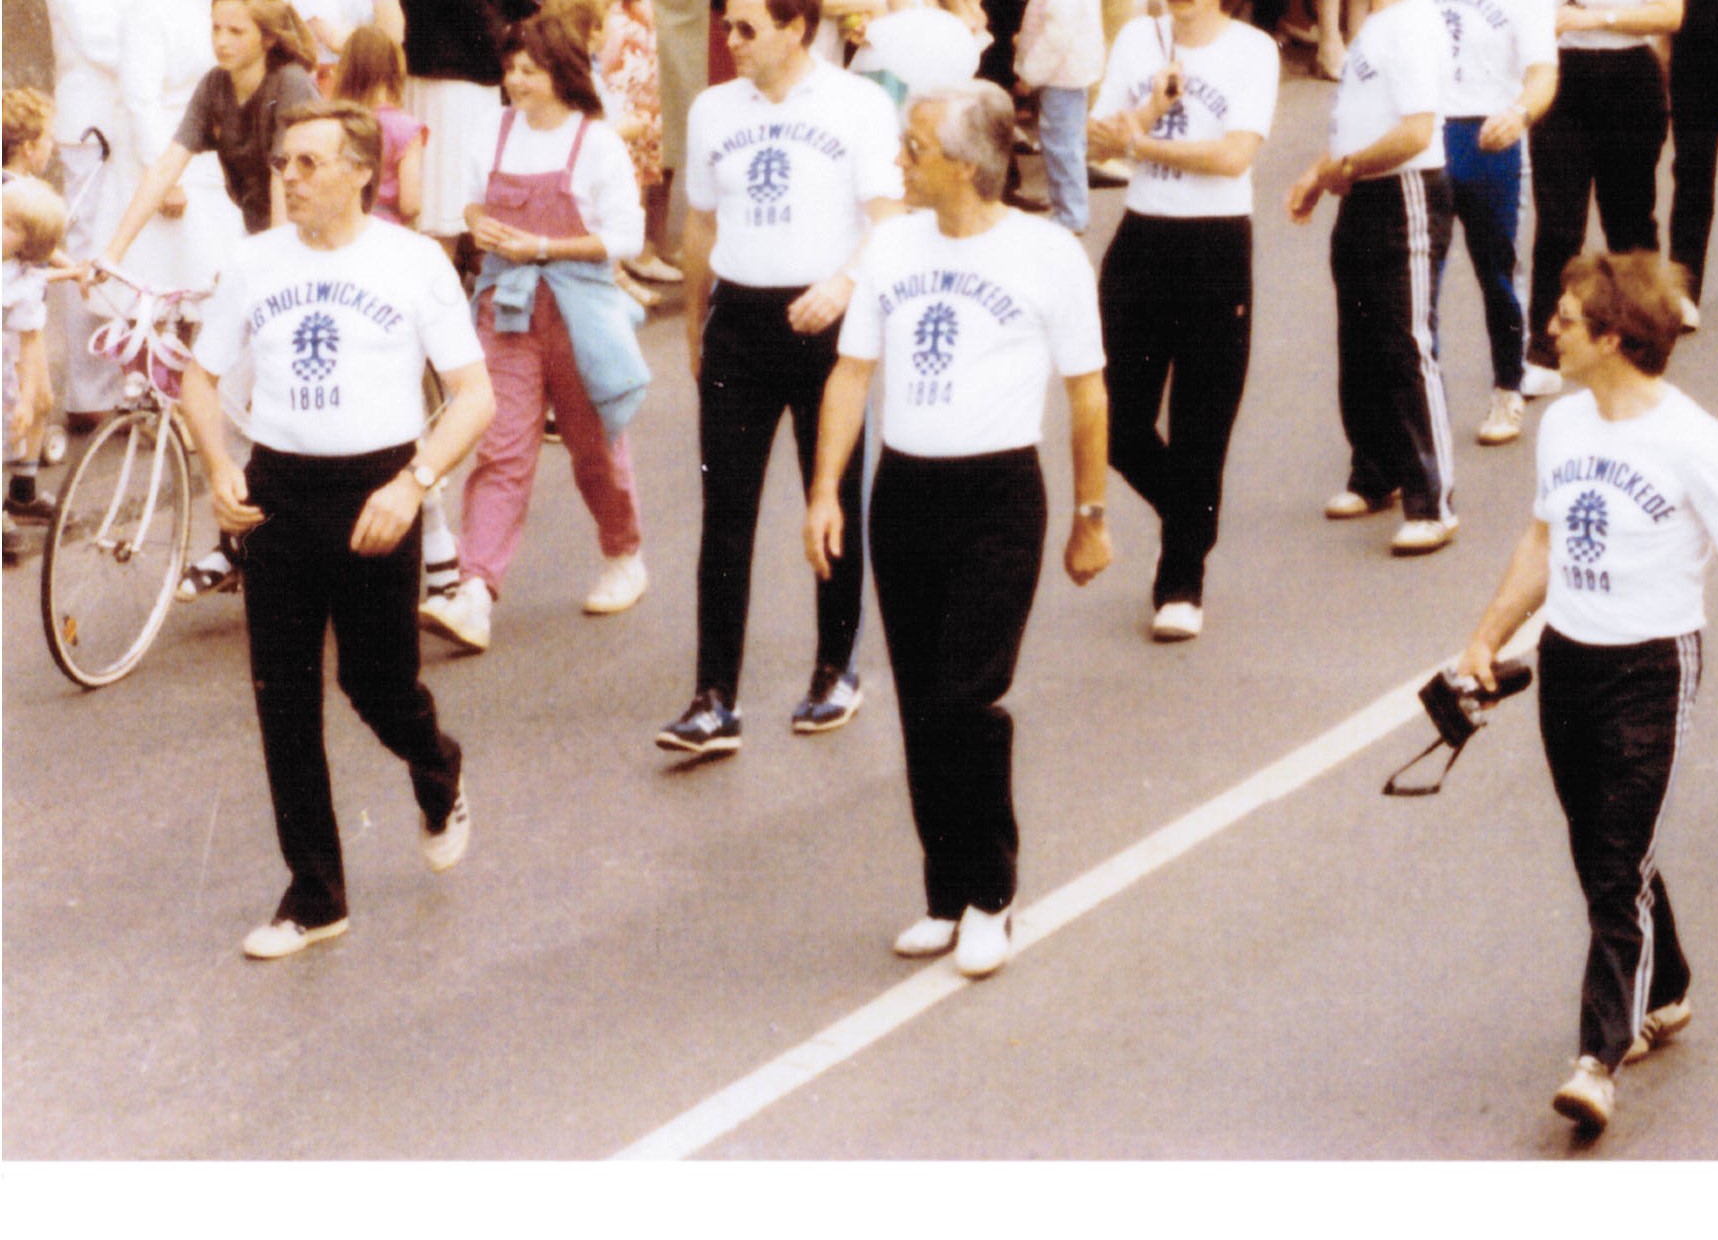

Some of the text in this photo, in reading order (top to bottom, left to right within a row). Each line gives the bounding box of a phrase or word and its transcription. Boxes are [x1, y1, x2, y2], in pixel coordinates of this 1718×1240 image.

[746, 205, 792, 227] 1884
[265, 281, 404, 334] HOLZWICKEDE
[893, 270, 1023, 327] HOLZWICKEDE
[290, 385, 340, 411] 1884
[908, 379, 953, 406] 1884
[1552, 456, 1677, 524] HOLZWICKEDE
[1563, 565, 1611, 593] 1884
